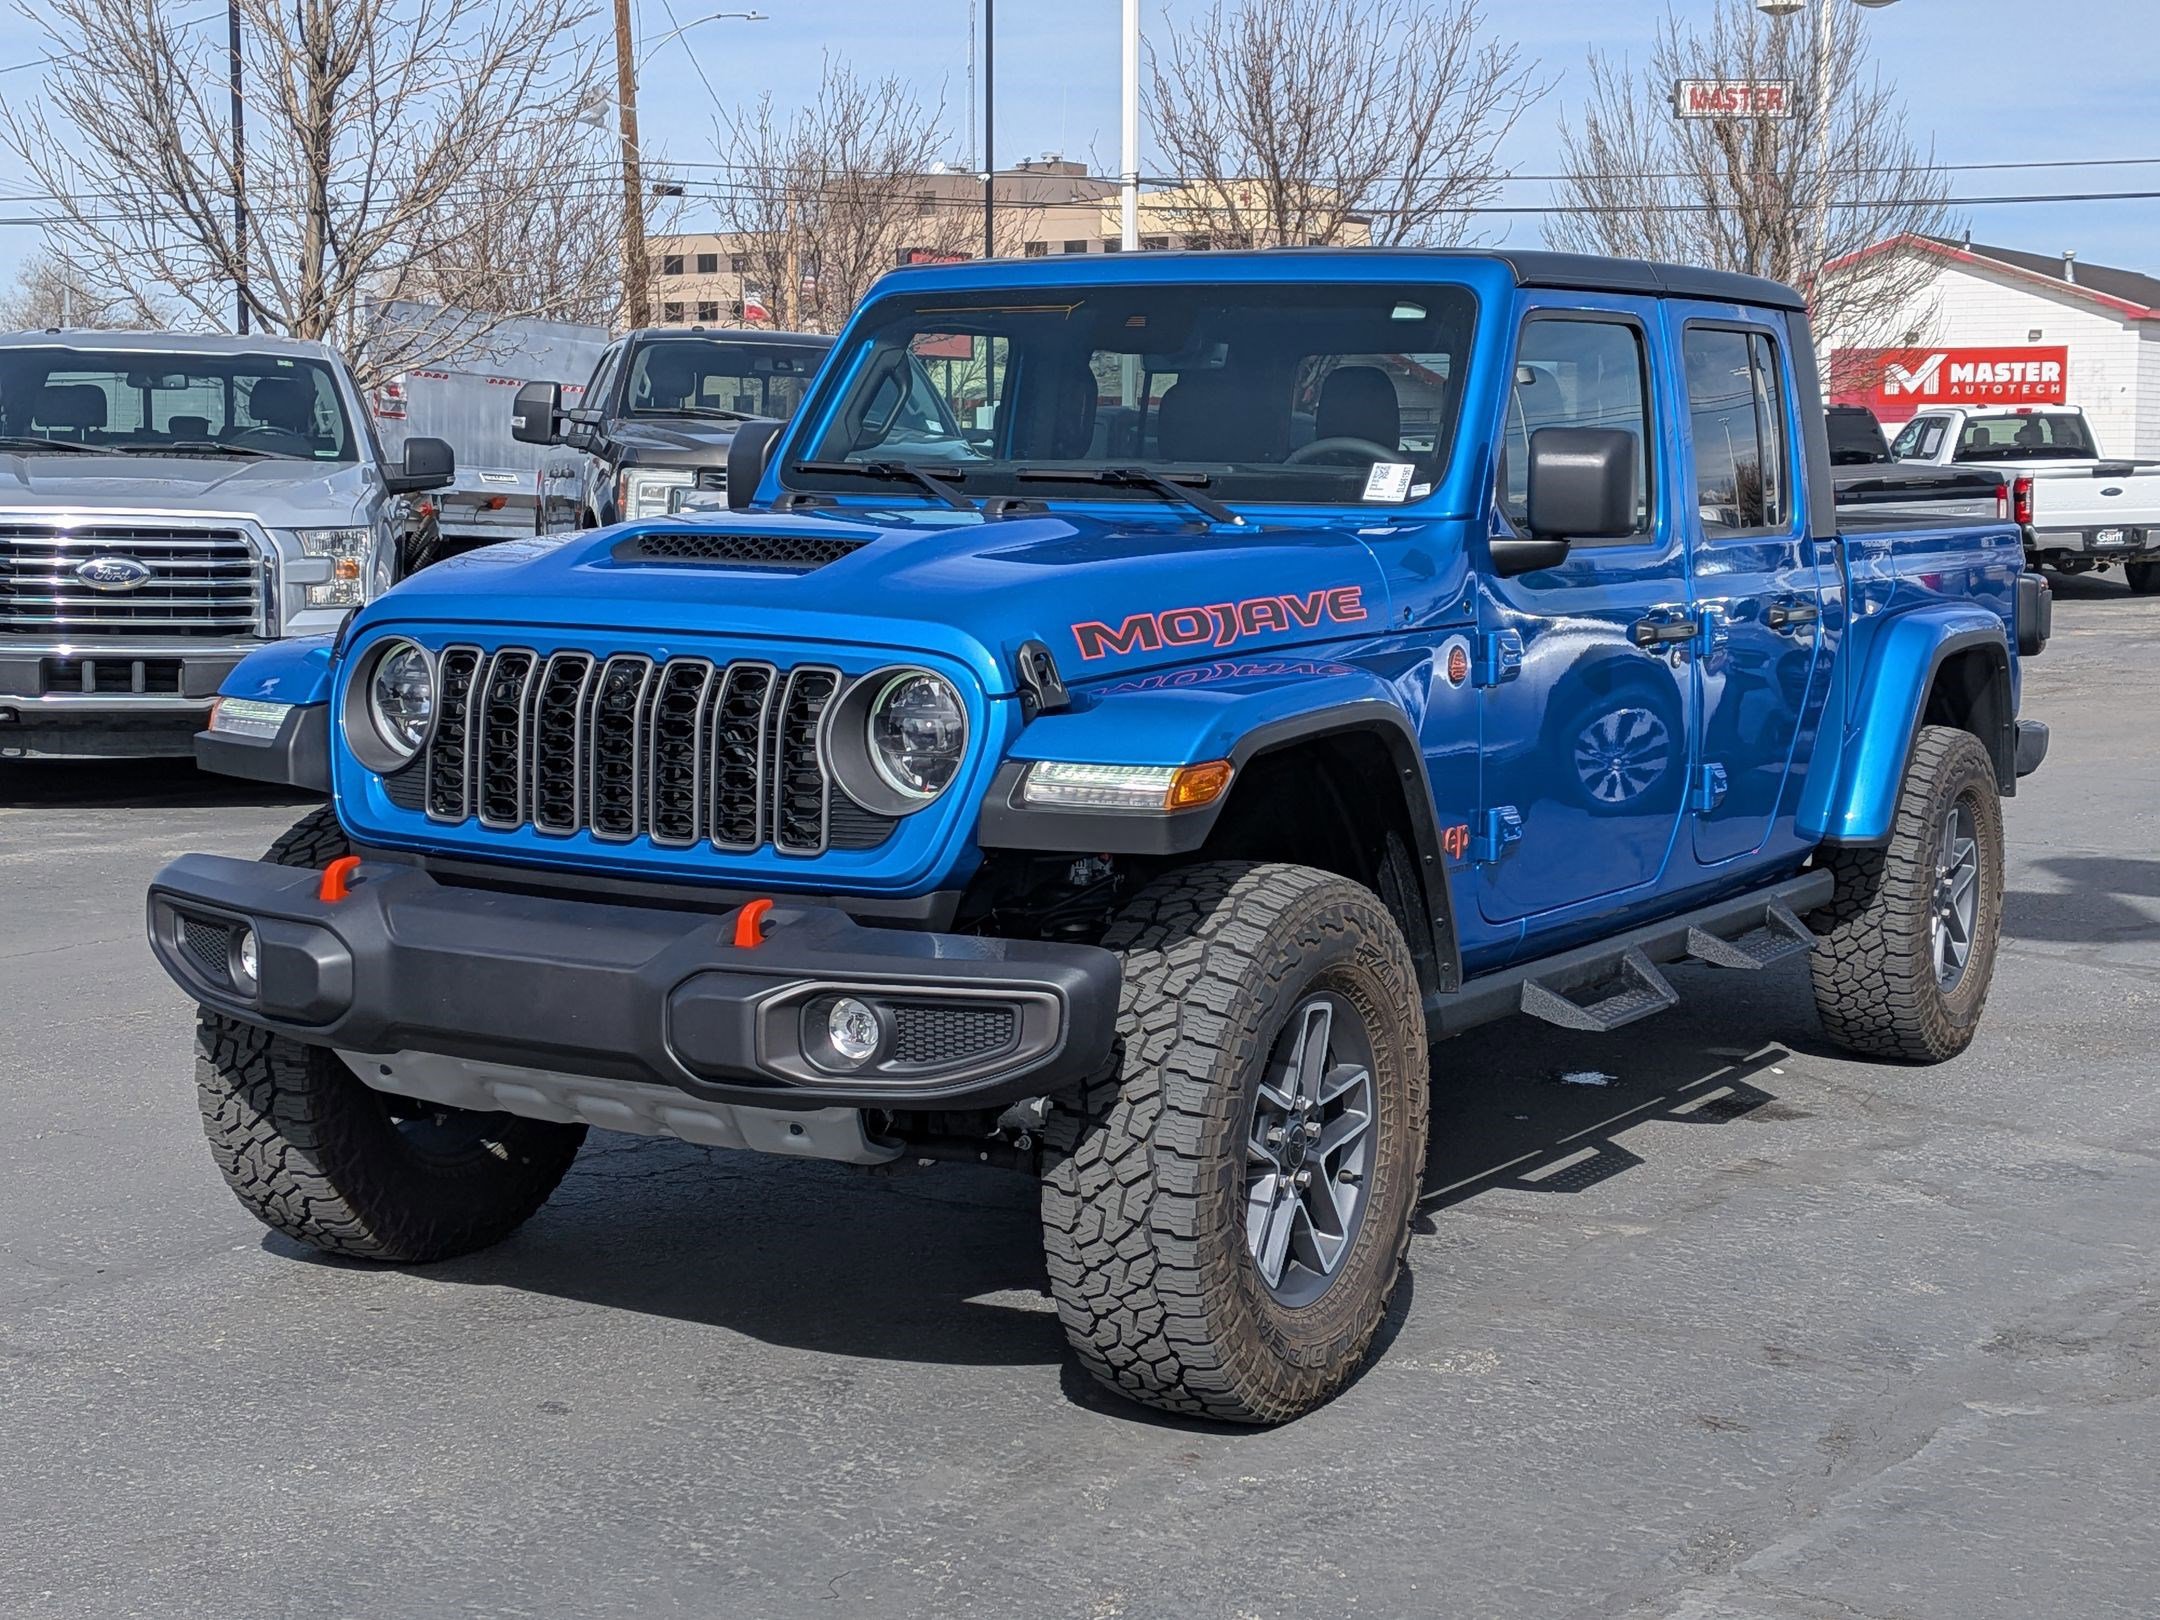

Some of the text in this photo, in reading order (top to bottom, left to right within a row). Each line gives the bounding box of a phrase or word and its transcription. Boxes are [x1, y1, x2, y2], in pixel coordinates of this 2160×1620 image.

[1689, 86, 1783, 113] MASTER
[1950, 361, 2061, 383] MASTER
[1950, 384, 2061, 395] AUTOTECH
[93, 565, 132, 581] Ford
[1071, 586, 1368, 661] MOJAVE
